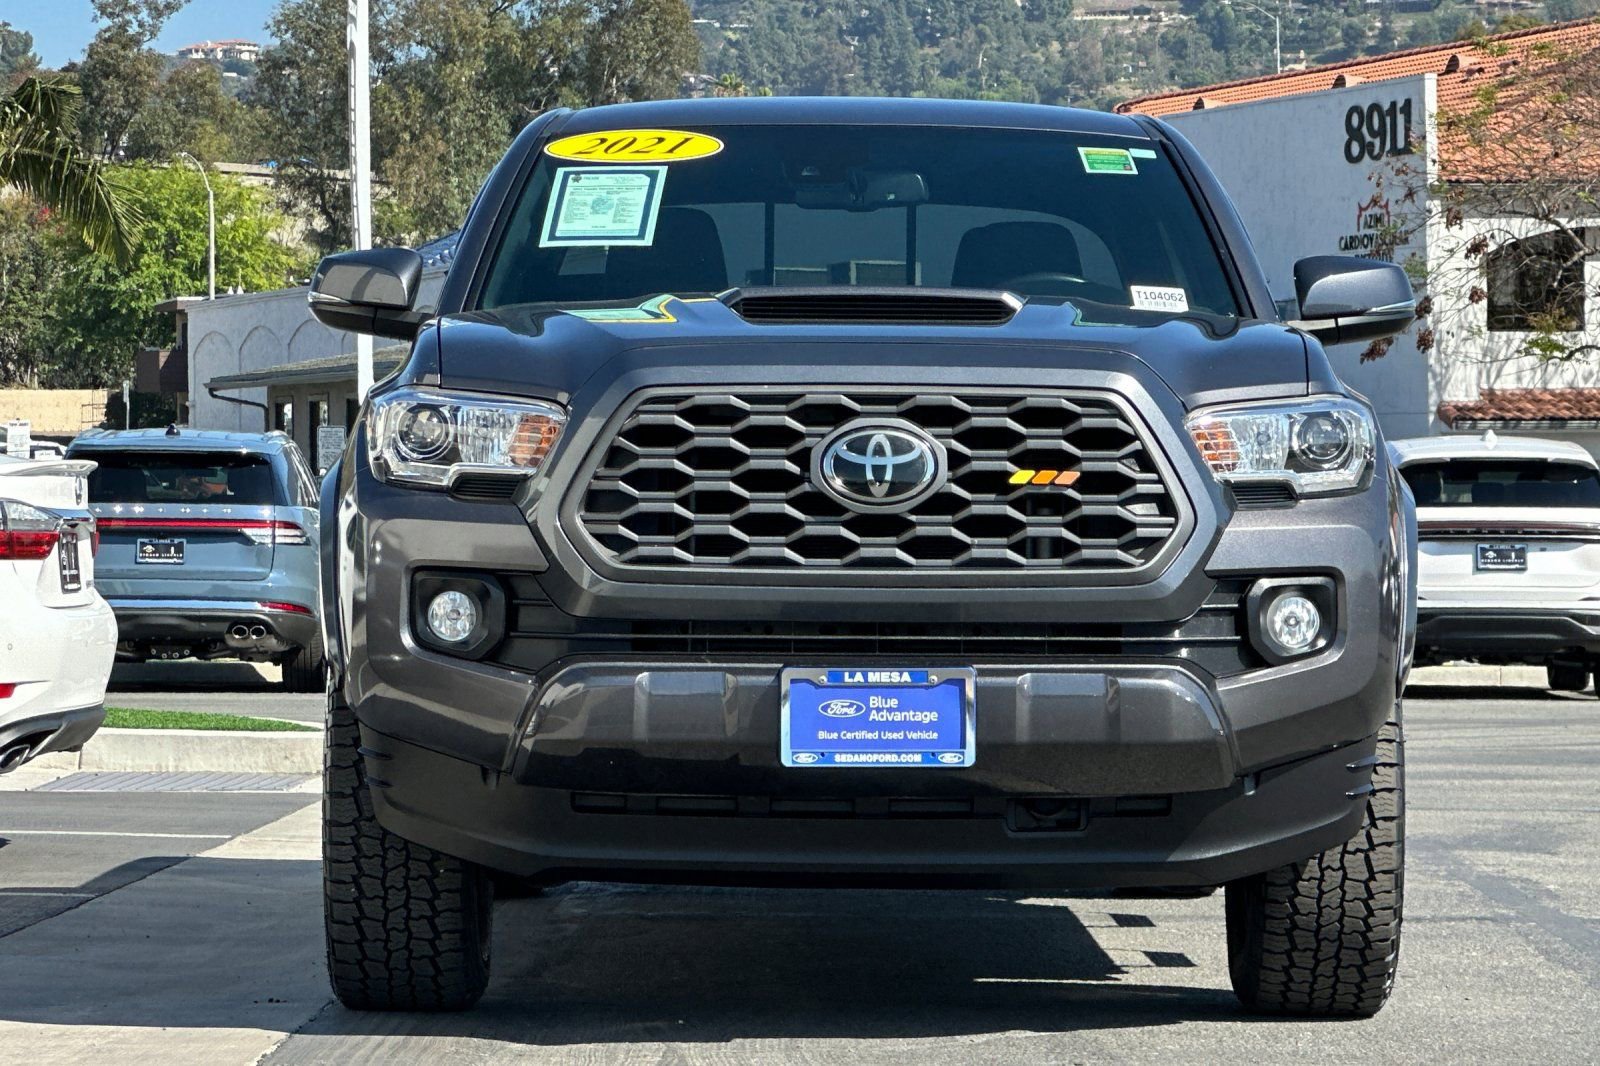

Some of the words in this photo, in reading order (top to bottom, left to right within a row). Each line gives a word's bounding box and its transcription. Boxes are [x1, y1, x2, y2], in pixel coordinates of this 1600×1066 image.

[1344, 98, 1414, 164] 8911
[571, 136, 695, 155] 2021
[1136, 291, 1184, 302] T104062
[844, 672, 864, 682] LA
[868, 672, 911, 682] MESA
[827, 702, 857, 714] Ford
[869, 696, 898, 708] Blue
[868, 710, 938, 723] Advantage
[818, 731, 838, 739] Blue
[841, 731, 878, 739] Certified
[881, 731, 904, 739] Used
[907, 731, 938, 739] Vehicle
